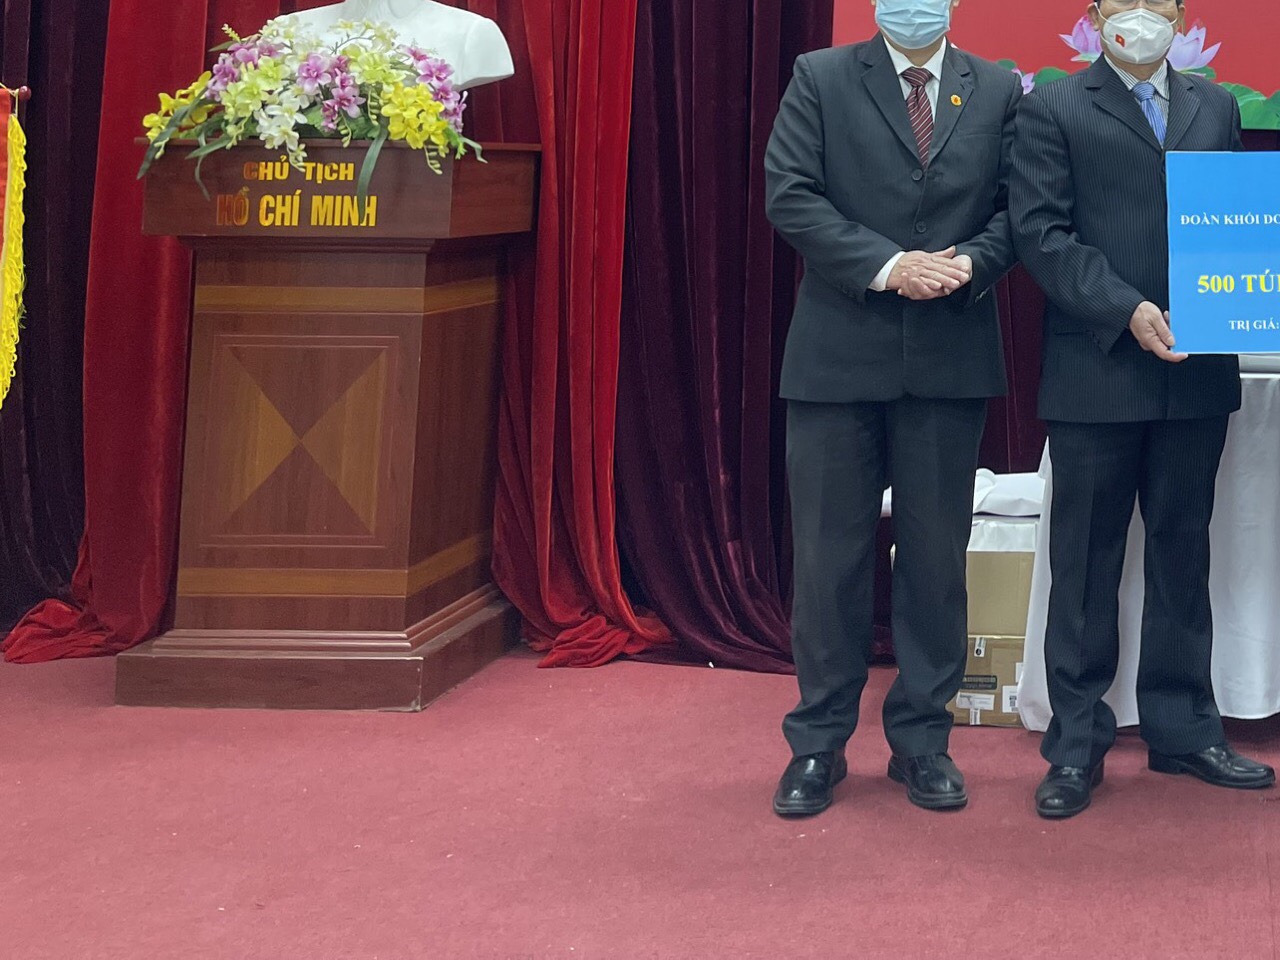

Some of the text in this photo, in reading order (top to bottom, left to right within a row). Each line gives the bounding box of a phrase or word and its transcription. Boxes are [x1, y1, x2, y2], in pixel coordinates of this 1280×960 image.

[243, 155, 355, 184] CHỦ TỊCH
[216, 186, 377, 227] HỒ CHÍ MINH
[1180, 212, 1220, 225] ĐOÀN
[1197, 274, 1235, 294] 500
[1228, 319, 1250, 332] TRỊ
[1253, 317, 1280, 330] GIÁ:
